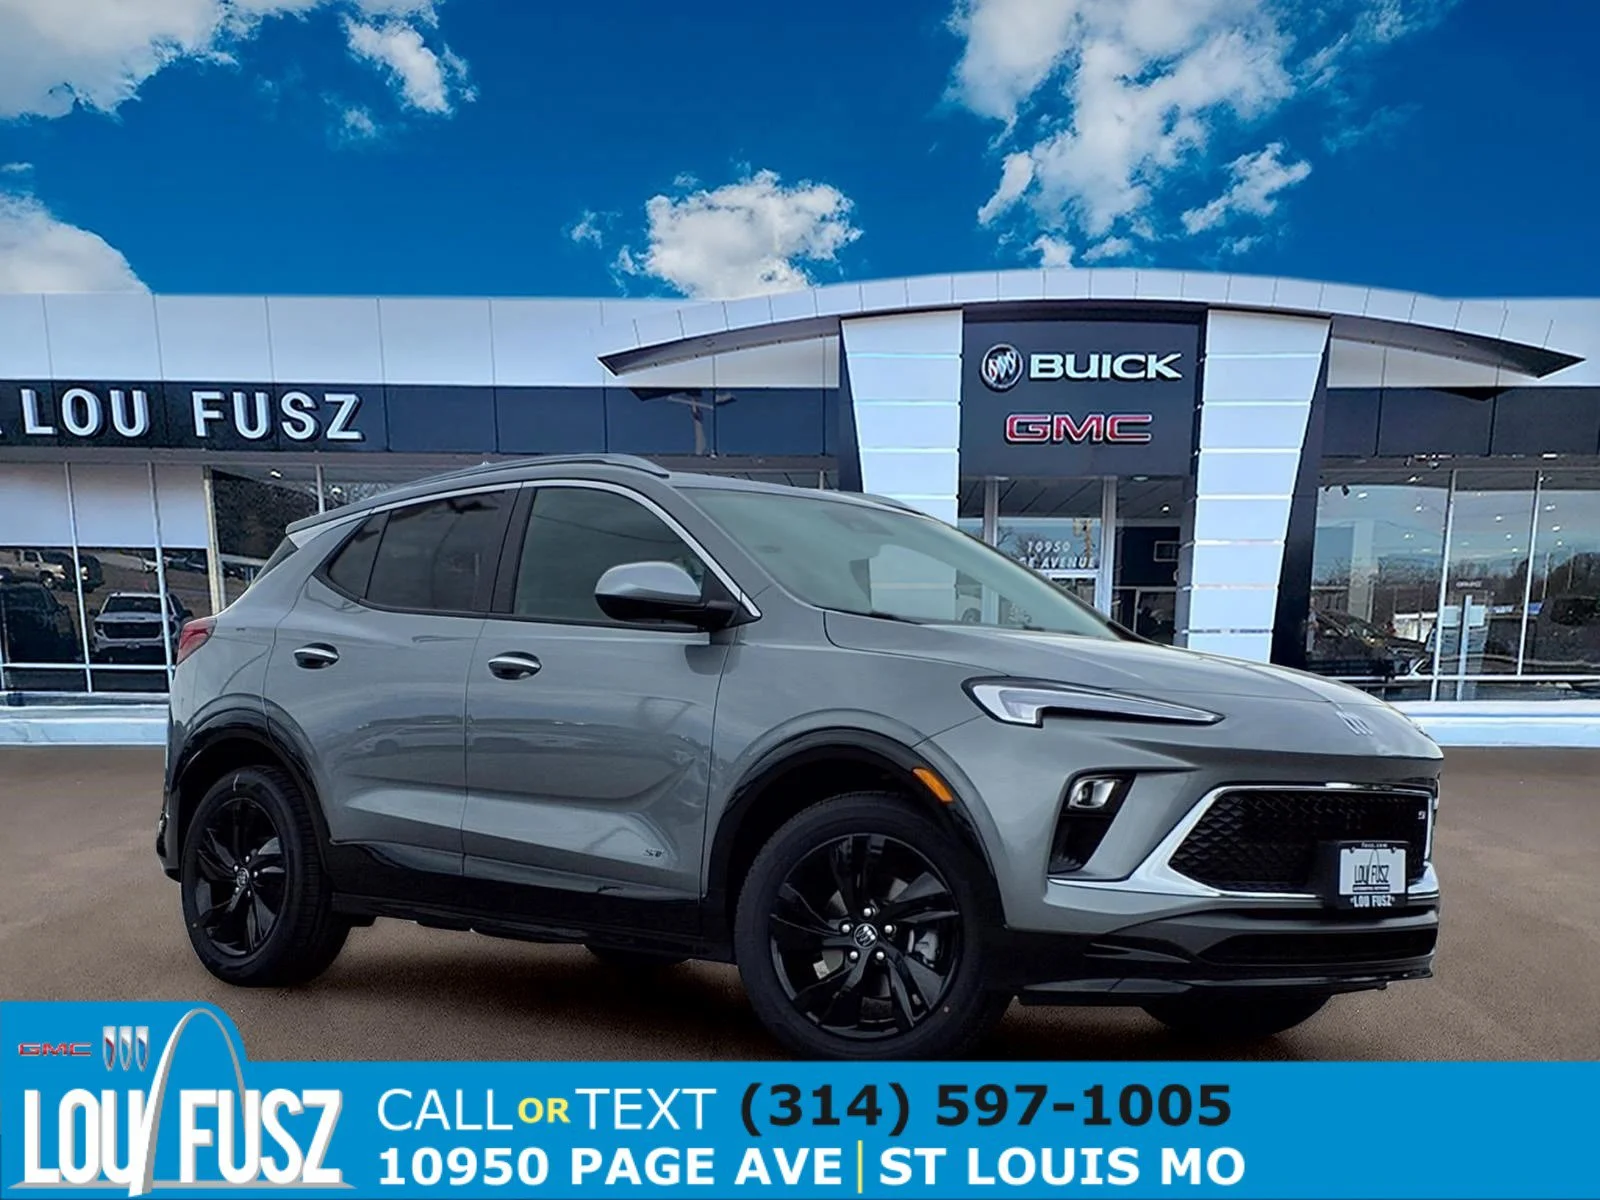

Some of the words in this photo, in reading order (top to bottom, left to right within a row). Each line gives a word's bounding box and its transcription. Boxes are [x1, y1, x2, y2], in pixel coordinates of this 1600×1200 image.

[1029, 353, 1183, 379] BUICK
[21, 388, 149, 437] LOU
[192, 391, 364, 441] FUSZ
[1006, 414, 1153, 442] GMC
[1027, 541, 1071, 553] 10950
[1040, 556, 1095, 569] AVENUE
[1372, 895, 1393, 908] FUSZ
